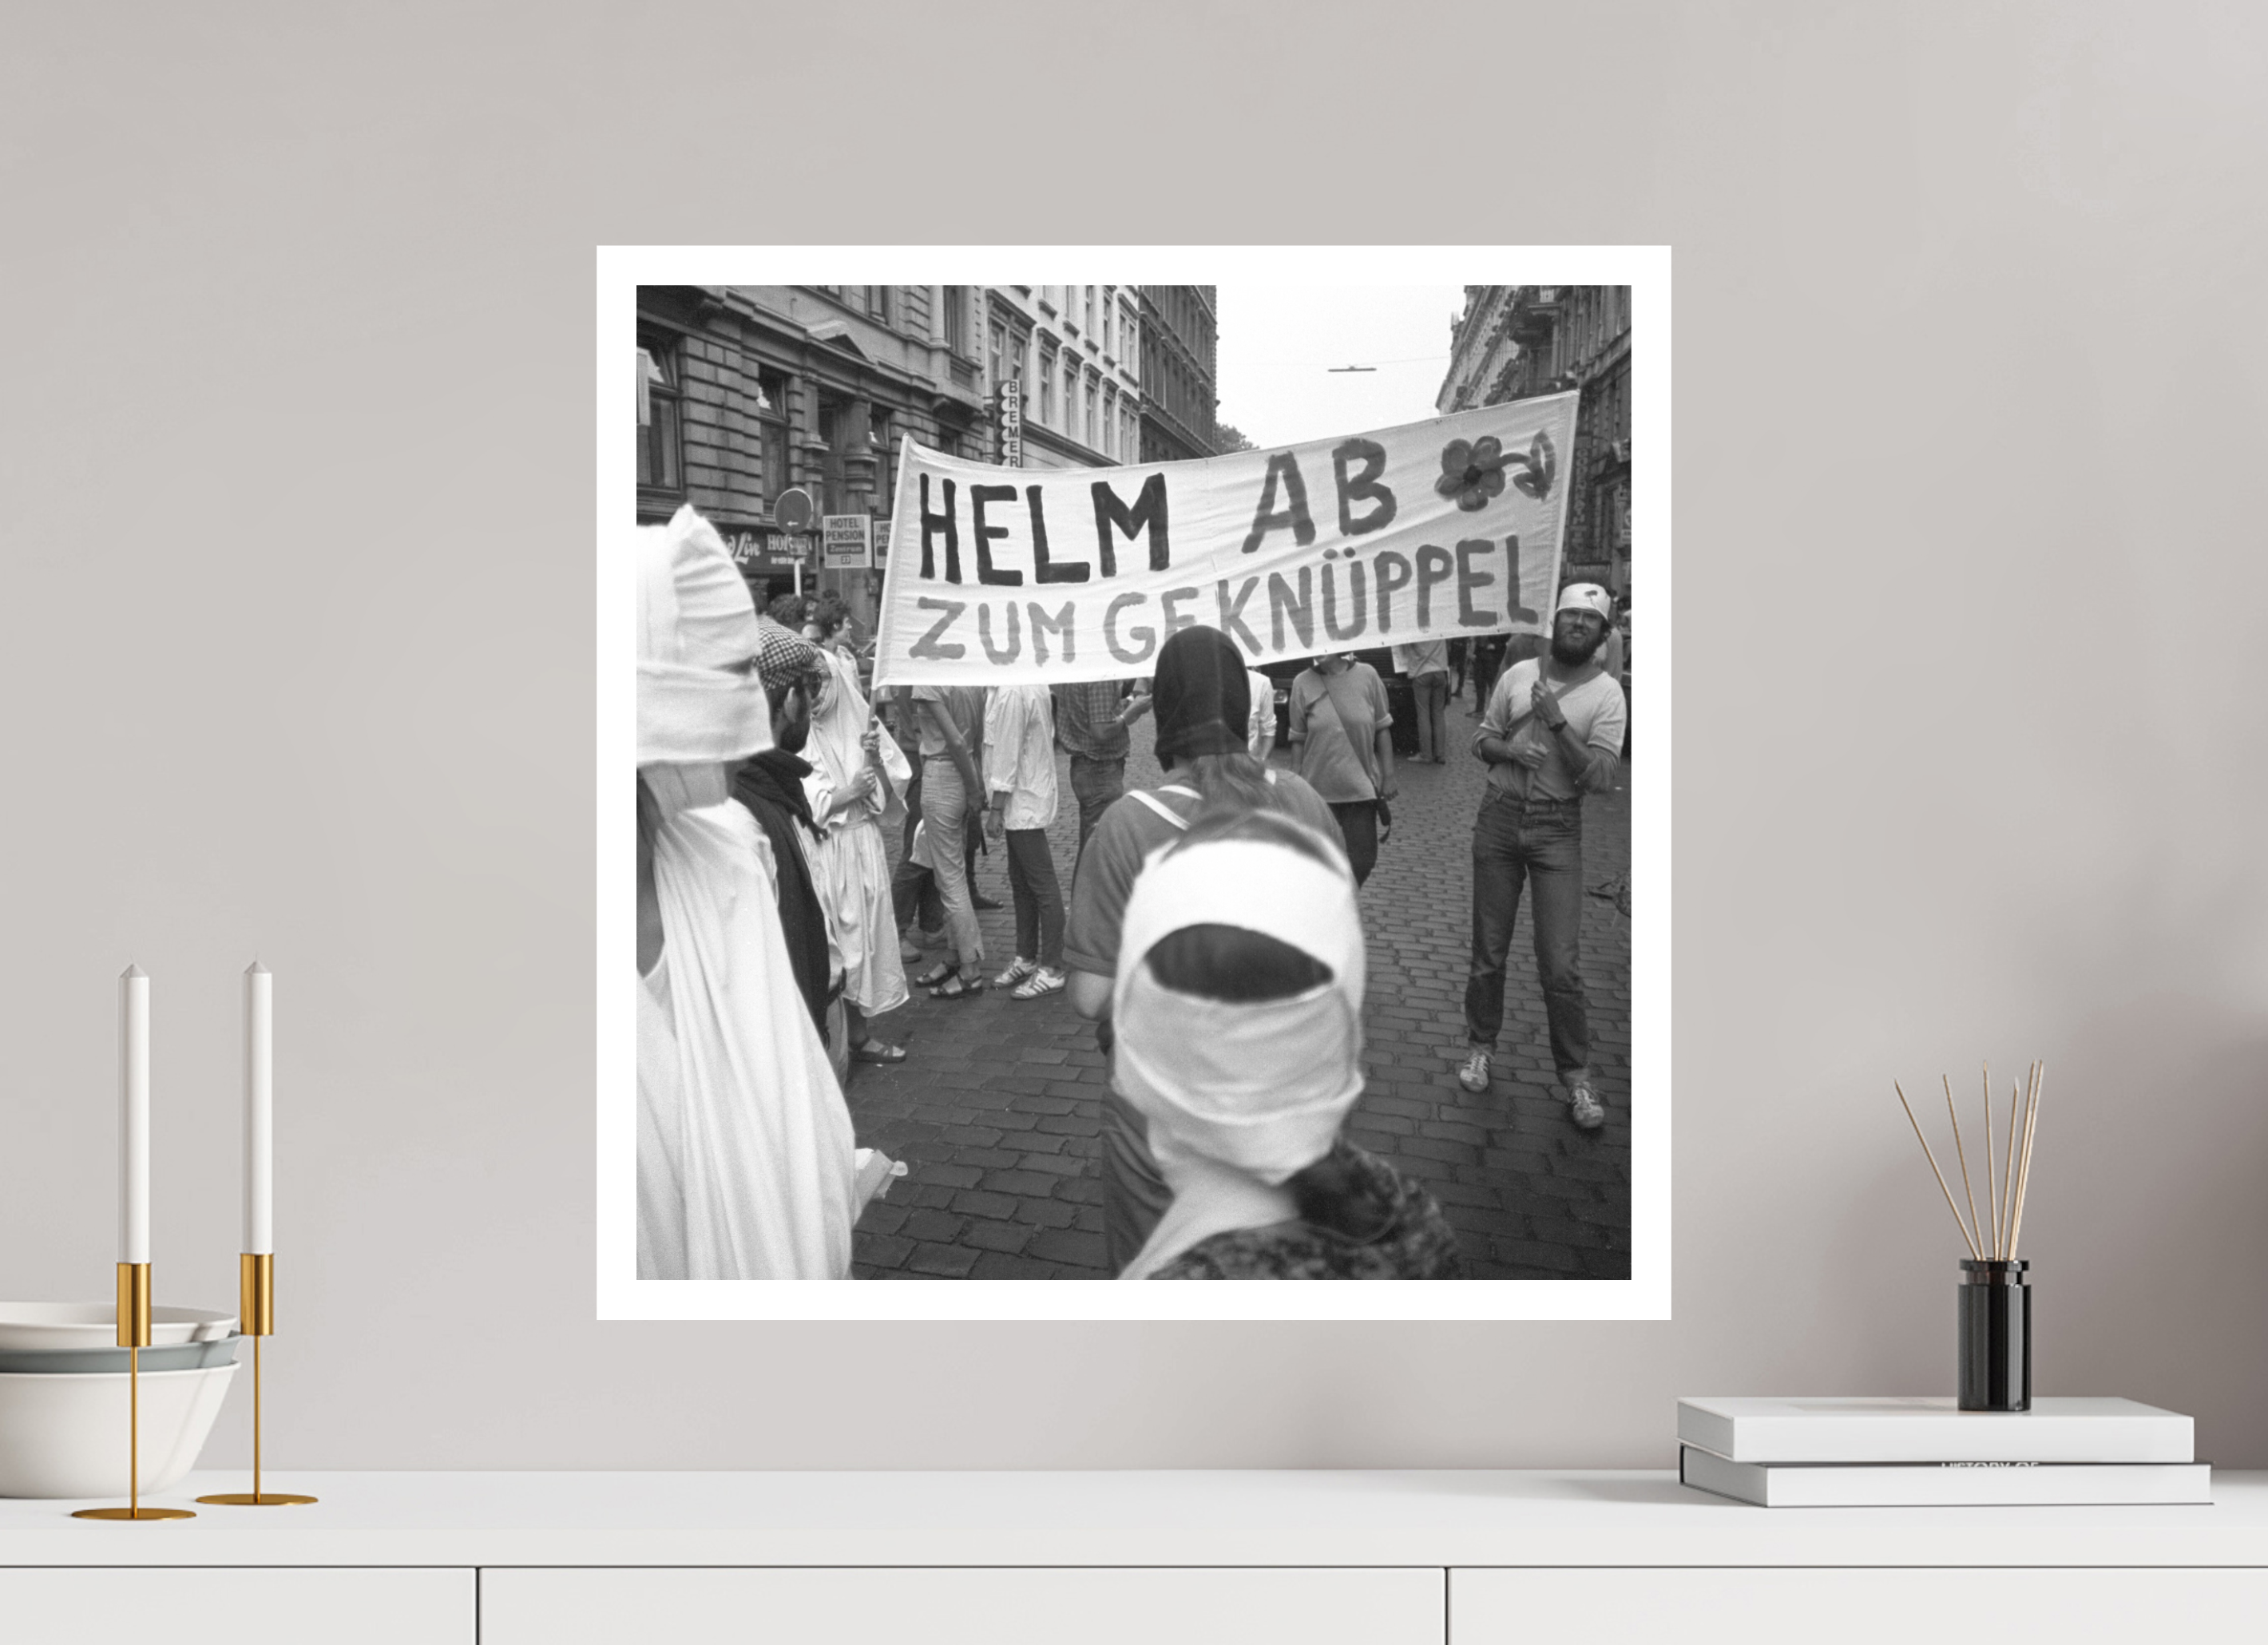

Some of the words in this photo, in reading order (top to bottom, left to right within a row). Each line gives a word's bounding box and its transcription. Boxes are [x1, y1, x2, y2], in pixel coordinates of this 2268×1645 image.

[1008, 380, 1019, 468] BREMER
[826, 530, 865, 541] PENSION
[831, 517, 859, 528] HOTEL
[919, 472, 1171, 587] HELM
[1241, 437, 1397, 553] AB
[908, 596, 1077, 667] ZUM
